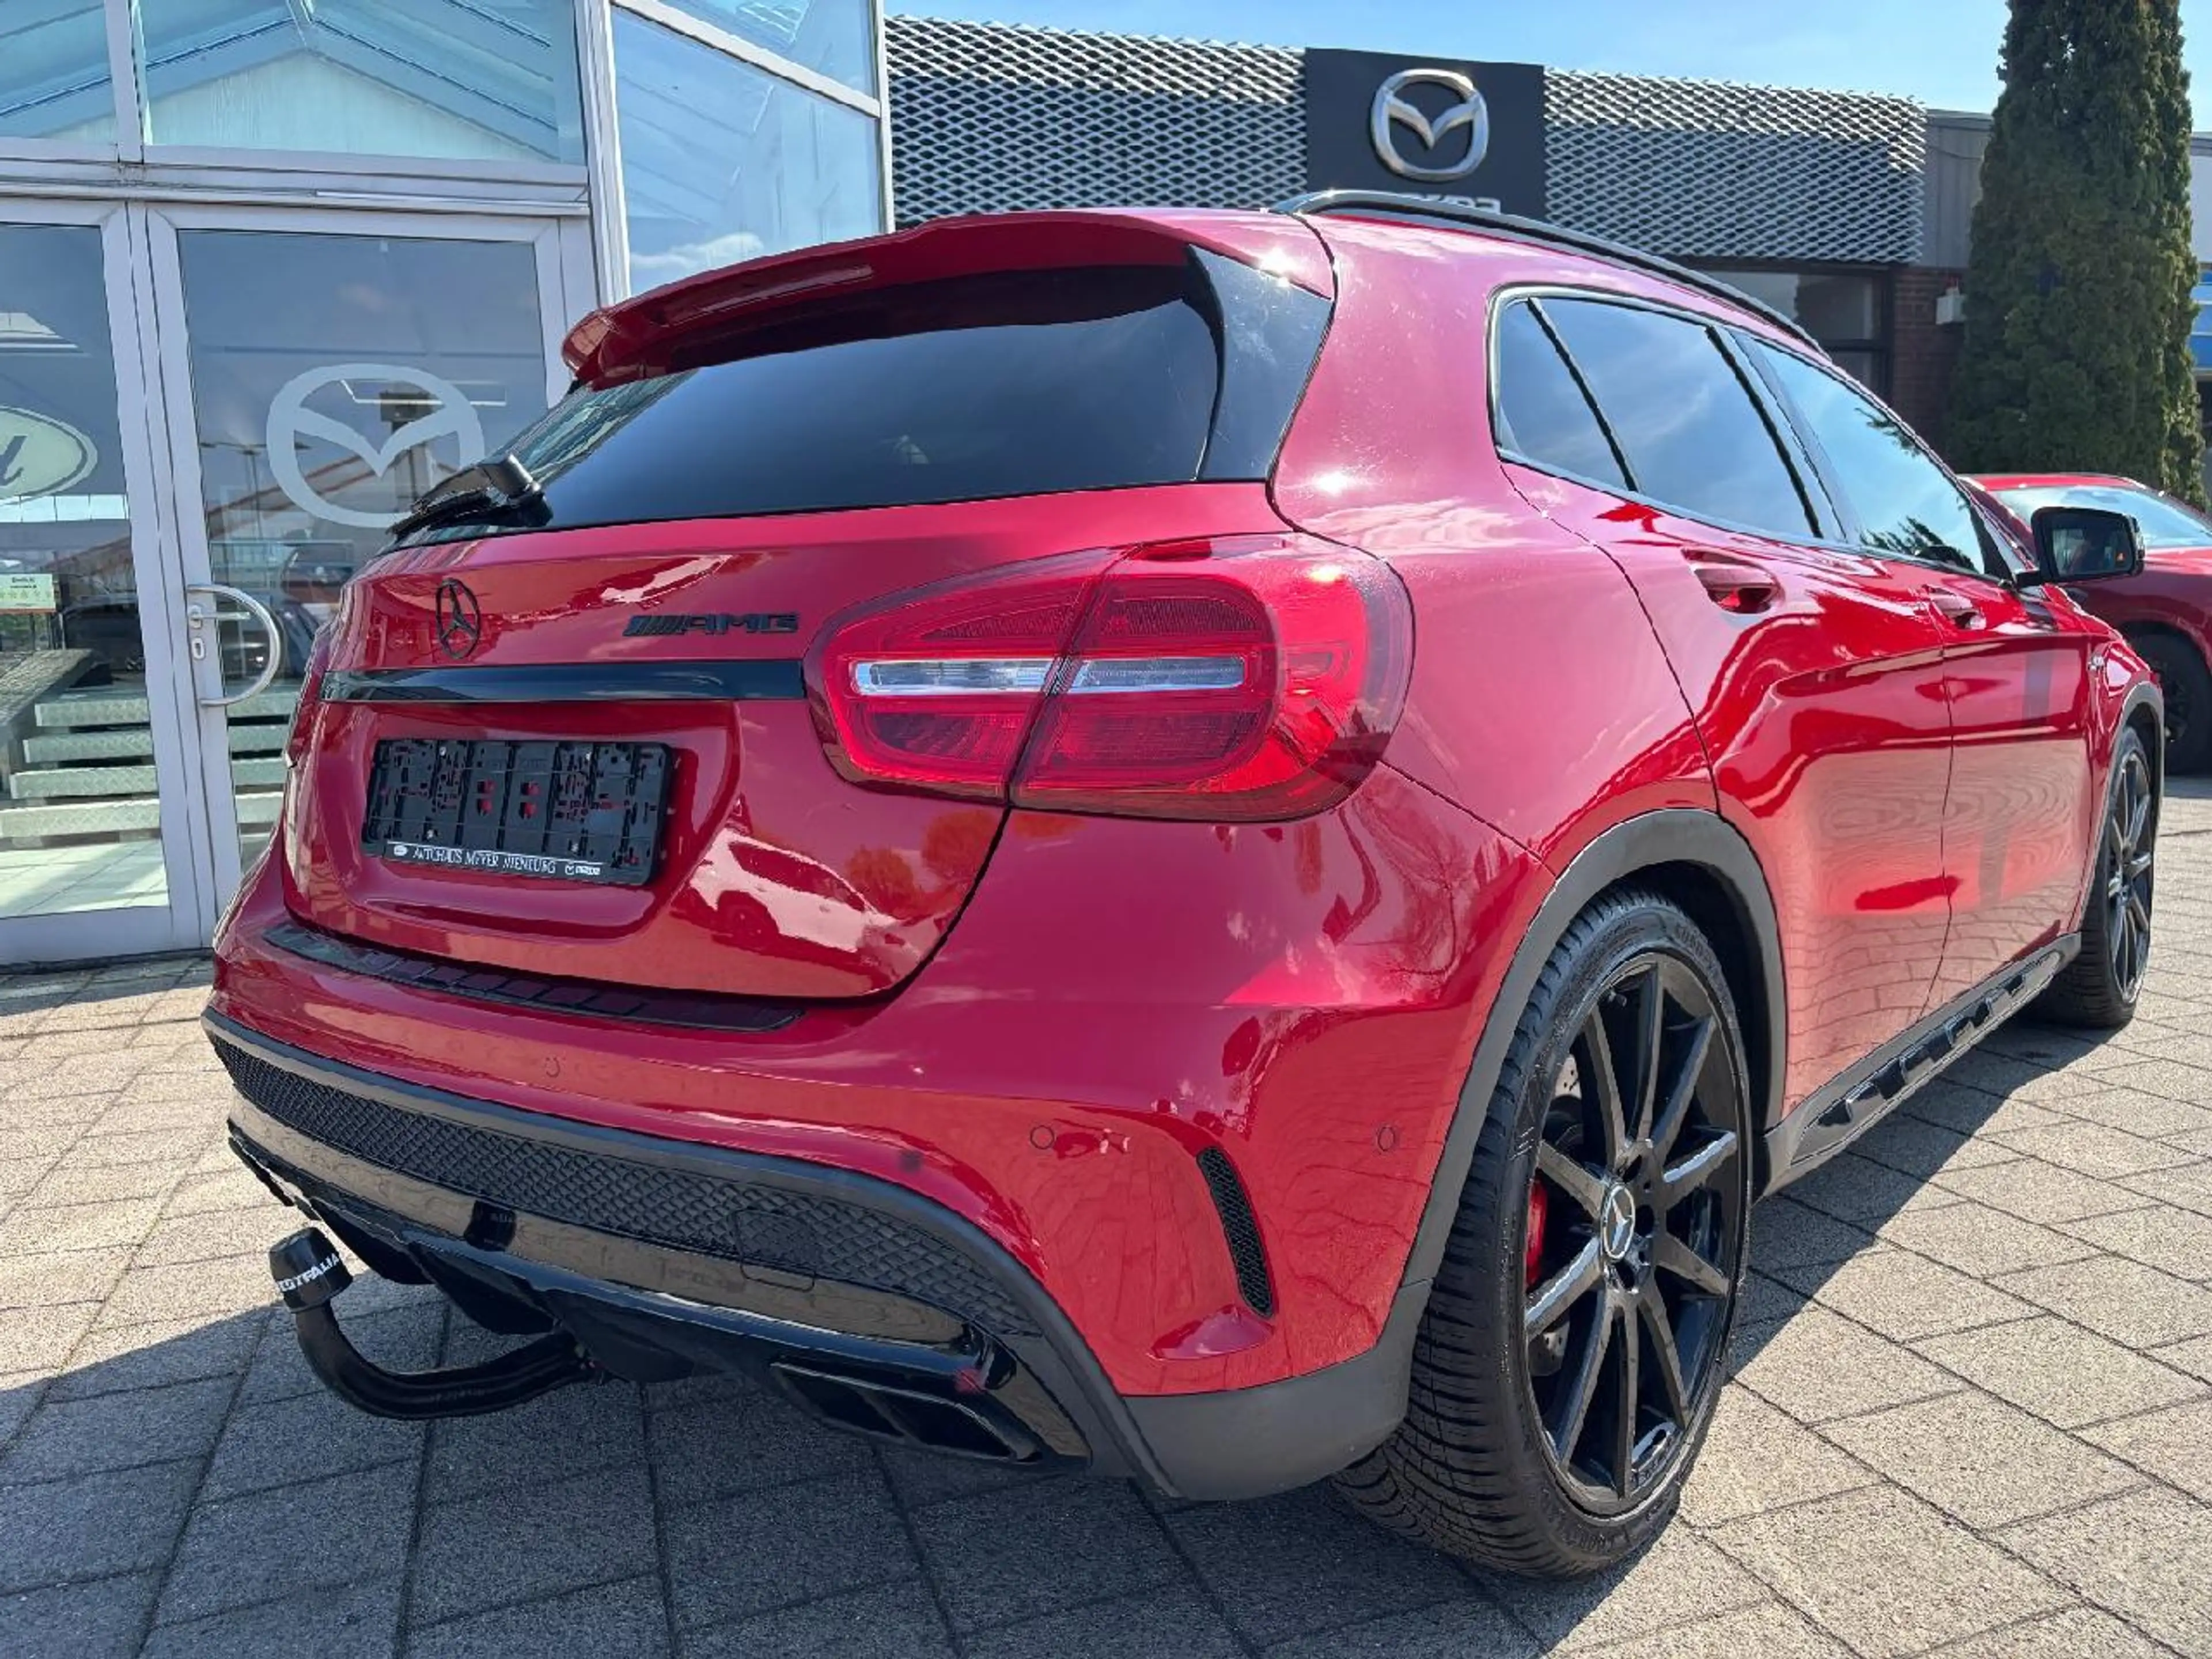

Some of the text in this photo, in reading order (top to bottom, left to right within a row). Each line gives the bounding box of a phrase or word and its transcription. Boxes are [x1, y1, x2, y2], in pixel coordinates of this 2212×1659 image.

[683, 614, 799, 635] AMG
[412, 846, 463, 864] AUTOHAUS
[464, 849, 499, 867] MEYER
